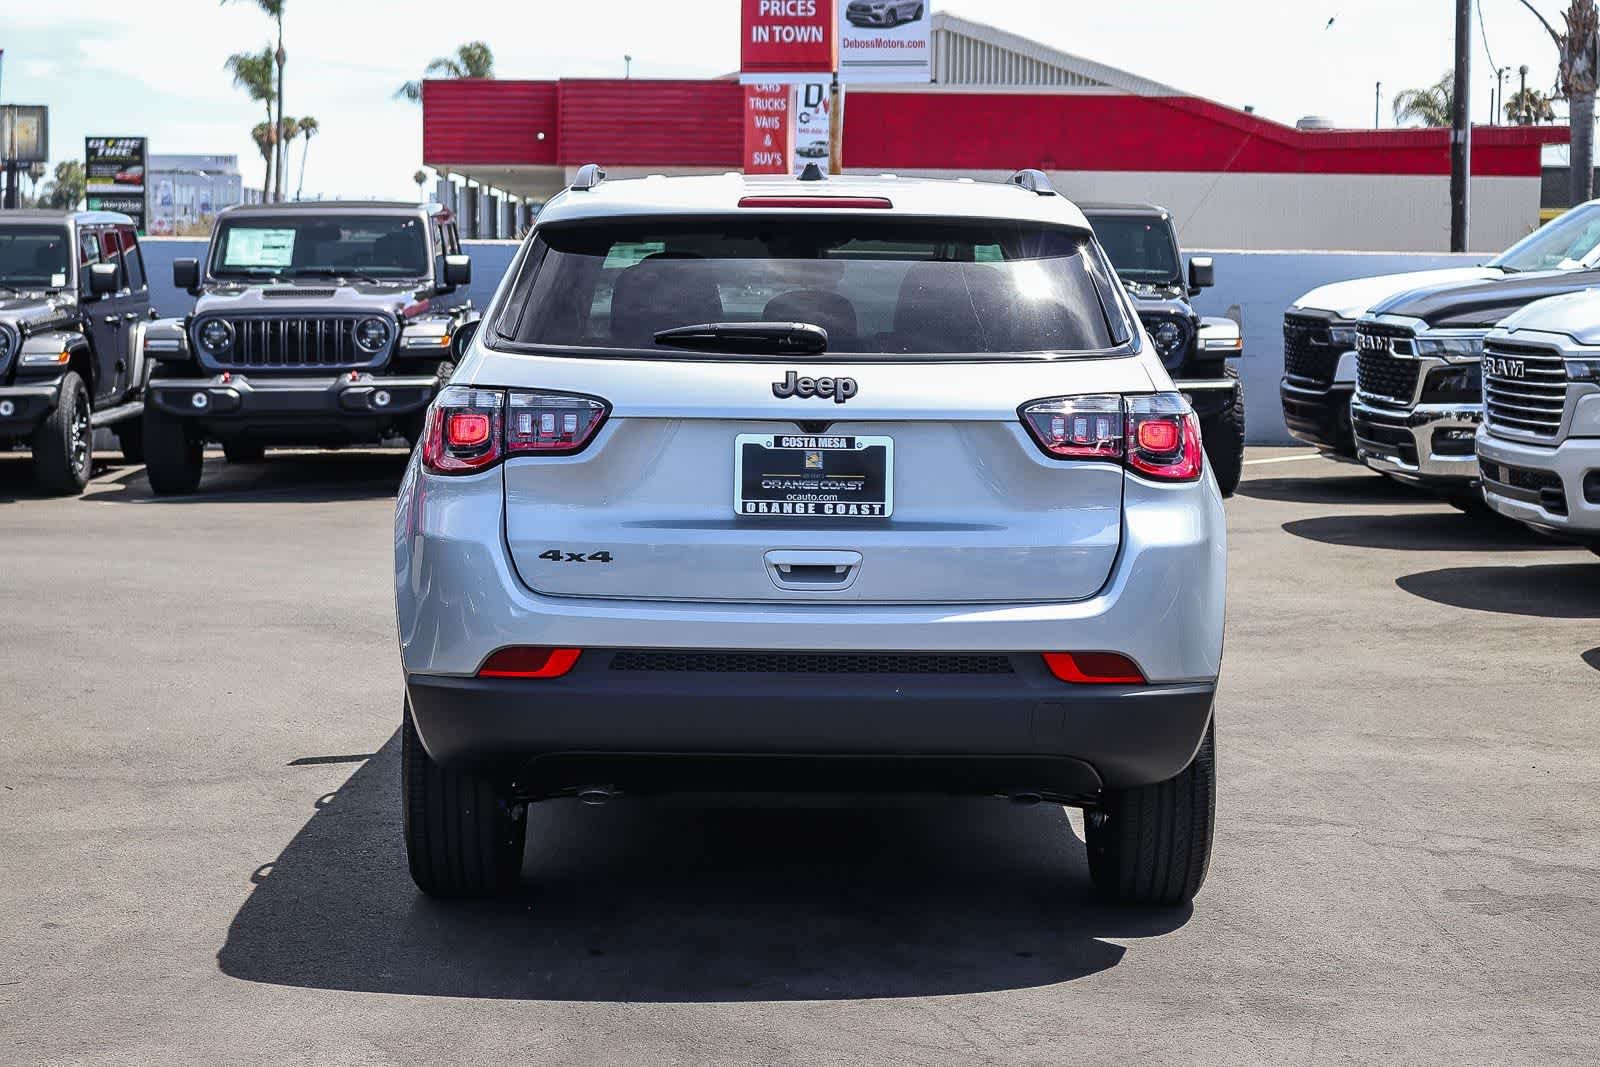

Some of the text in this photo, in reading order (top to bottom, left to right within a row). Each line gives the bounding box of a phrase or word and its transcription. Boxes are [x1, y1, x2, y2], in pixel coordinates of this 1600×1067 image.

[759, 0, 816, 16] PRICES
[752, 25, 823, 43] IN TOWN
[843, 38, 926, 49] DebossMotors.com
[749, 97, 786, 111] TRUCKS
[754, 115, 780, 128] VANS
[764, 133, 772, 146] &
[752, 151, 782, 166] SUV'S
[1484, 356, 1525, 378] RAM
[771, 371, 858, 404] Jeep
[782, 437, 847, 449] COSTA MESA
[761, 479, 865, 491] ORANGE COAST
[786, 493, 838, 502] ocauto.com
[746, 502, 882, 515] ORANGE COAST
[538, 549, 614, 562] 4x4
